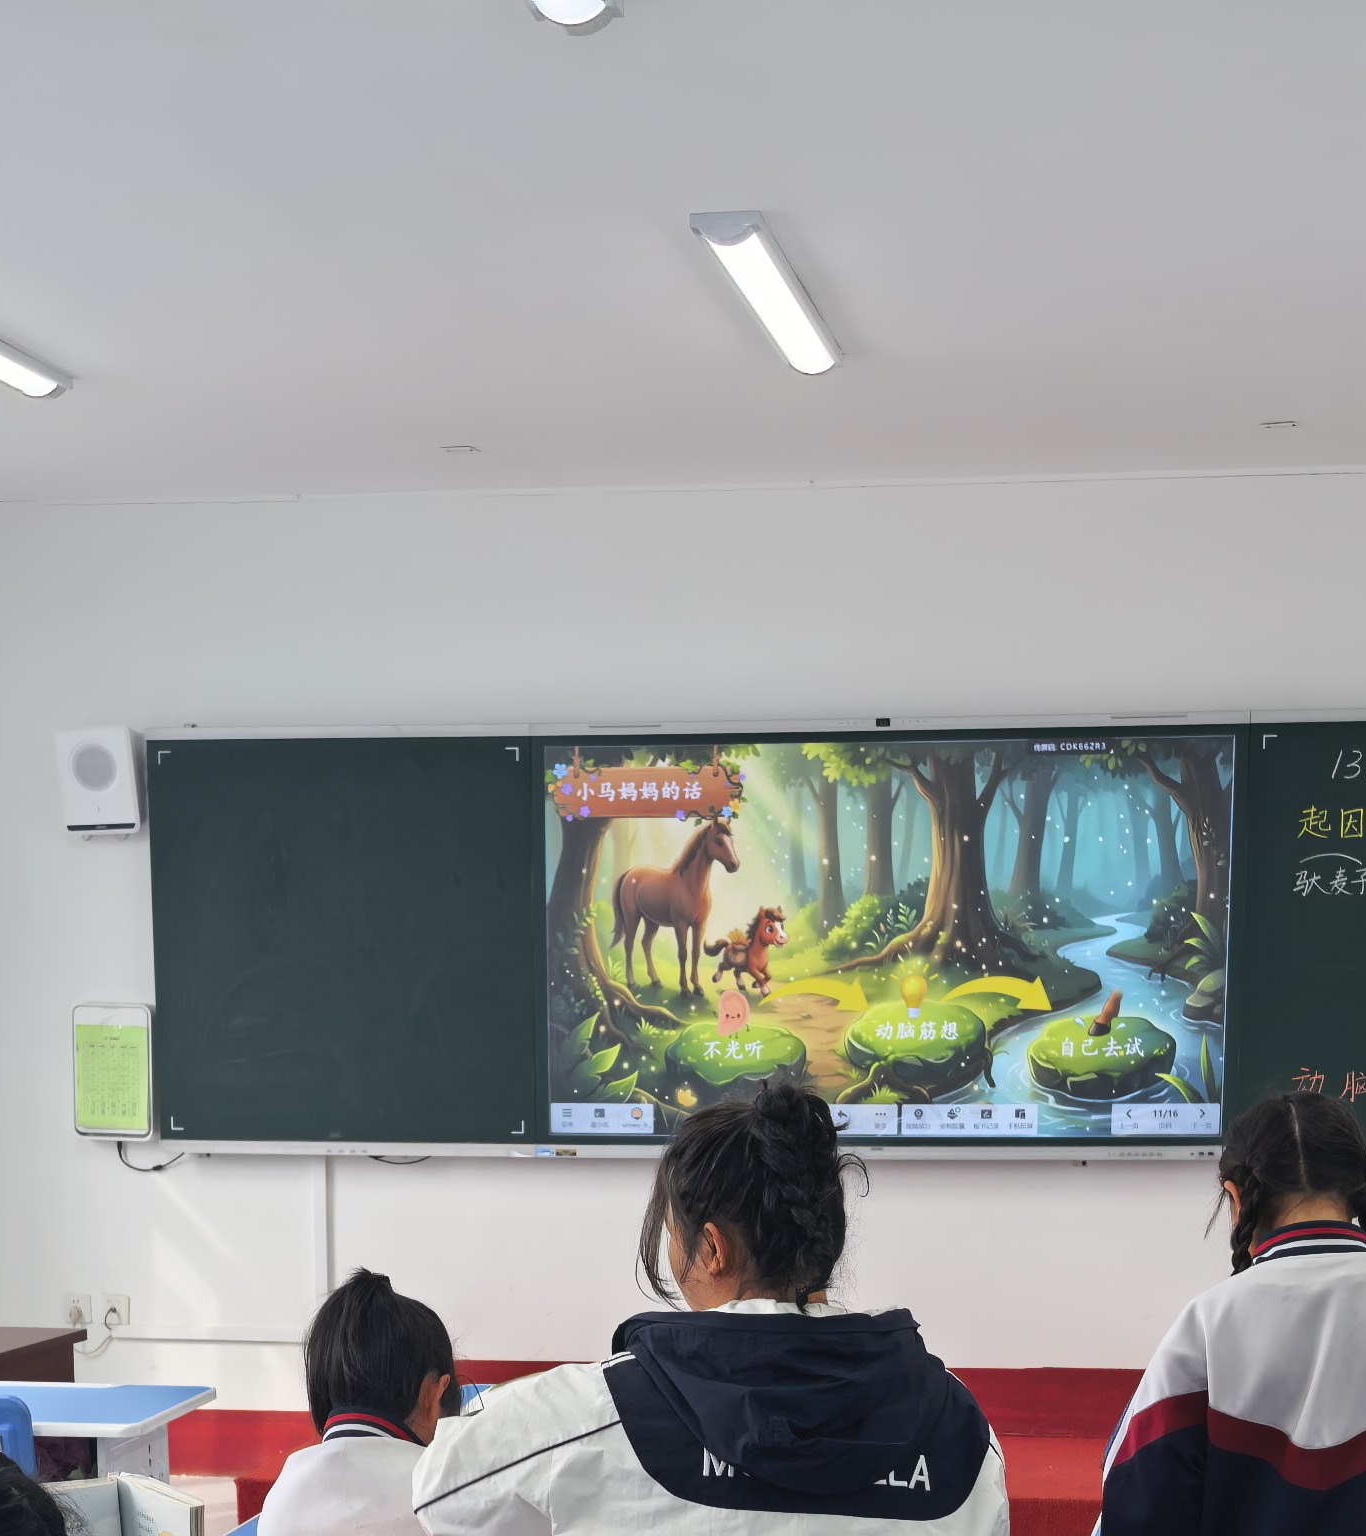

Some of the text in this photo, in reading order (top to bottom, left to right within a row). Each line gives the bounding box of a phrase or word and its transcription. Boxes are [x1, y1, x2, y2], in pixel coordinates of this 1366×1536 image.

[576, 781, 703, 802] 小马妈妈的话
[1297, 805, 1365, 839] 起因
[875, 1021, 959, 1041] 动脑筋想
[703, 1040, 764, 1060] 不光听
[1061, 1036, 1144, 1057] 自己去试
[1153, 1109, 1179, 1119] 11/16
